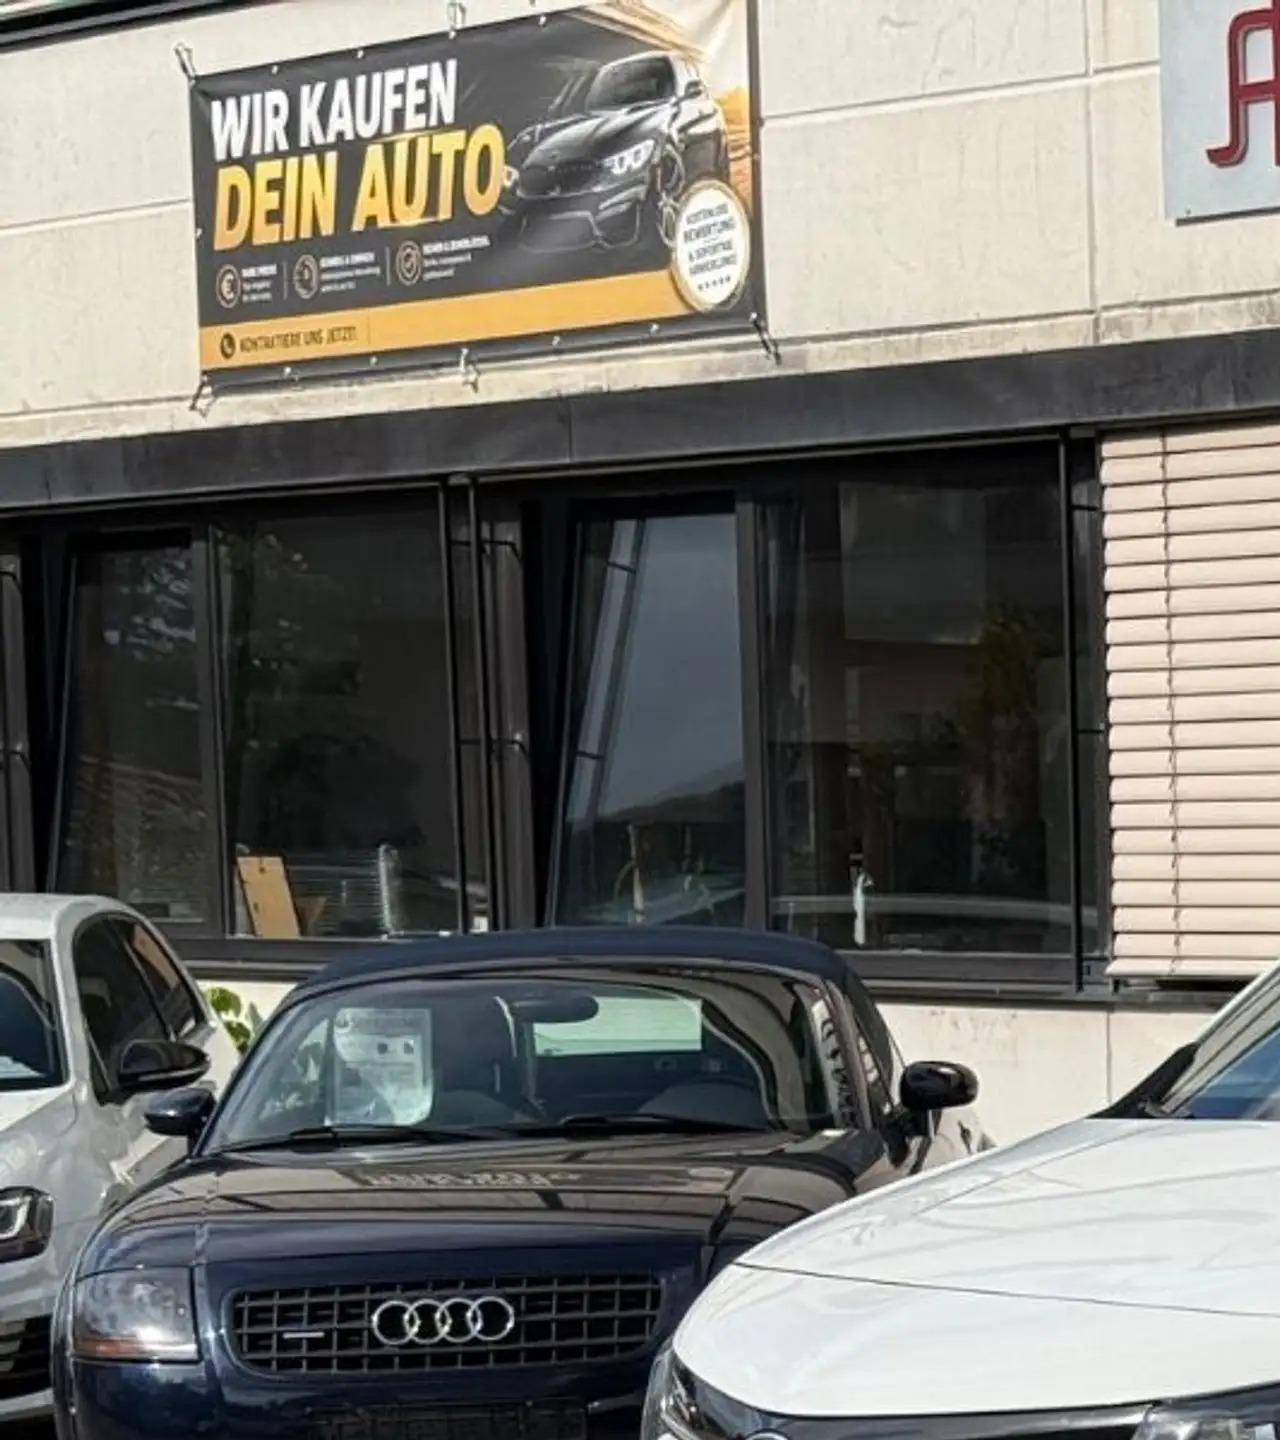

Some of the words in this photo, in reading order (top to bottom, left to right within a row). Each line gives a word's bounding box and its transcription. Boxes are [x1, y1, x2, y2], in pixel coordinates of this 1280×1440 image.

[210, 89, 289, 162] WIR
[299, 58, 459, 147] KAUFEN
[212, 151, 338, 252] DEIN
[351, 123, 505, 231] AUTO
